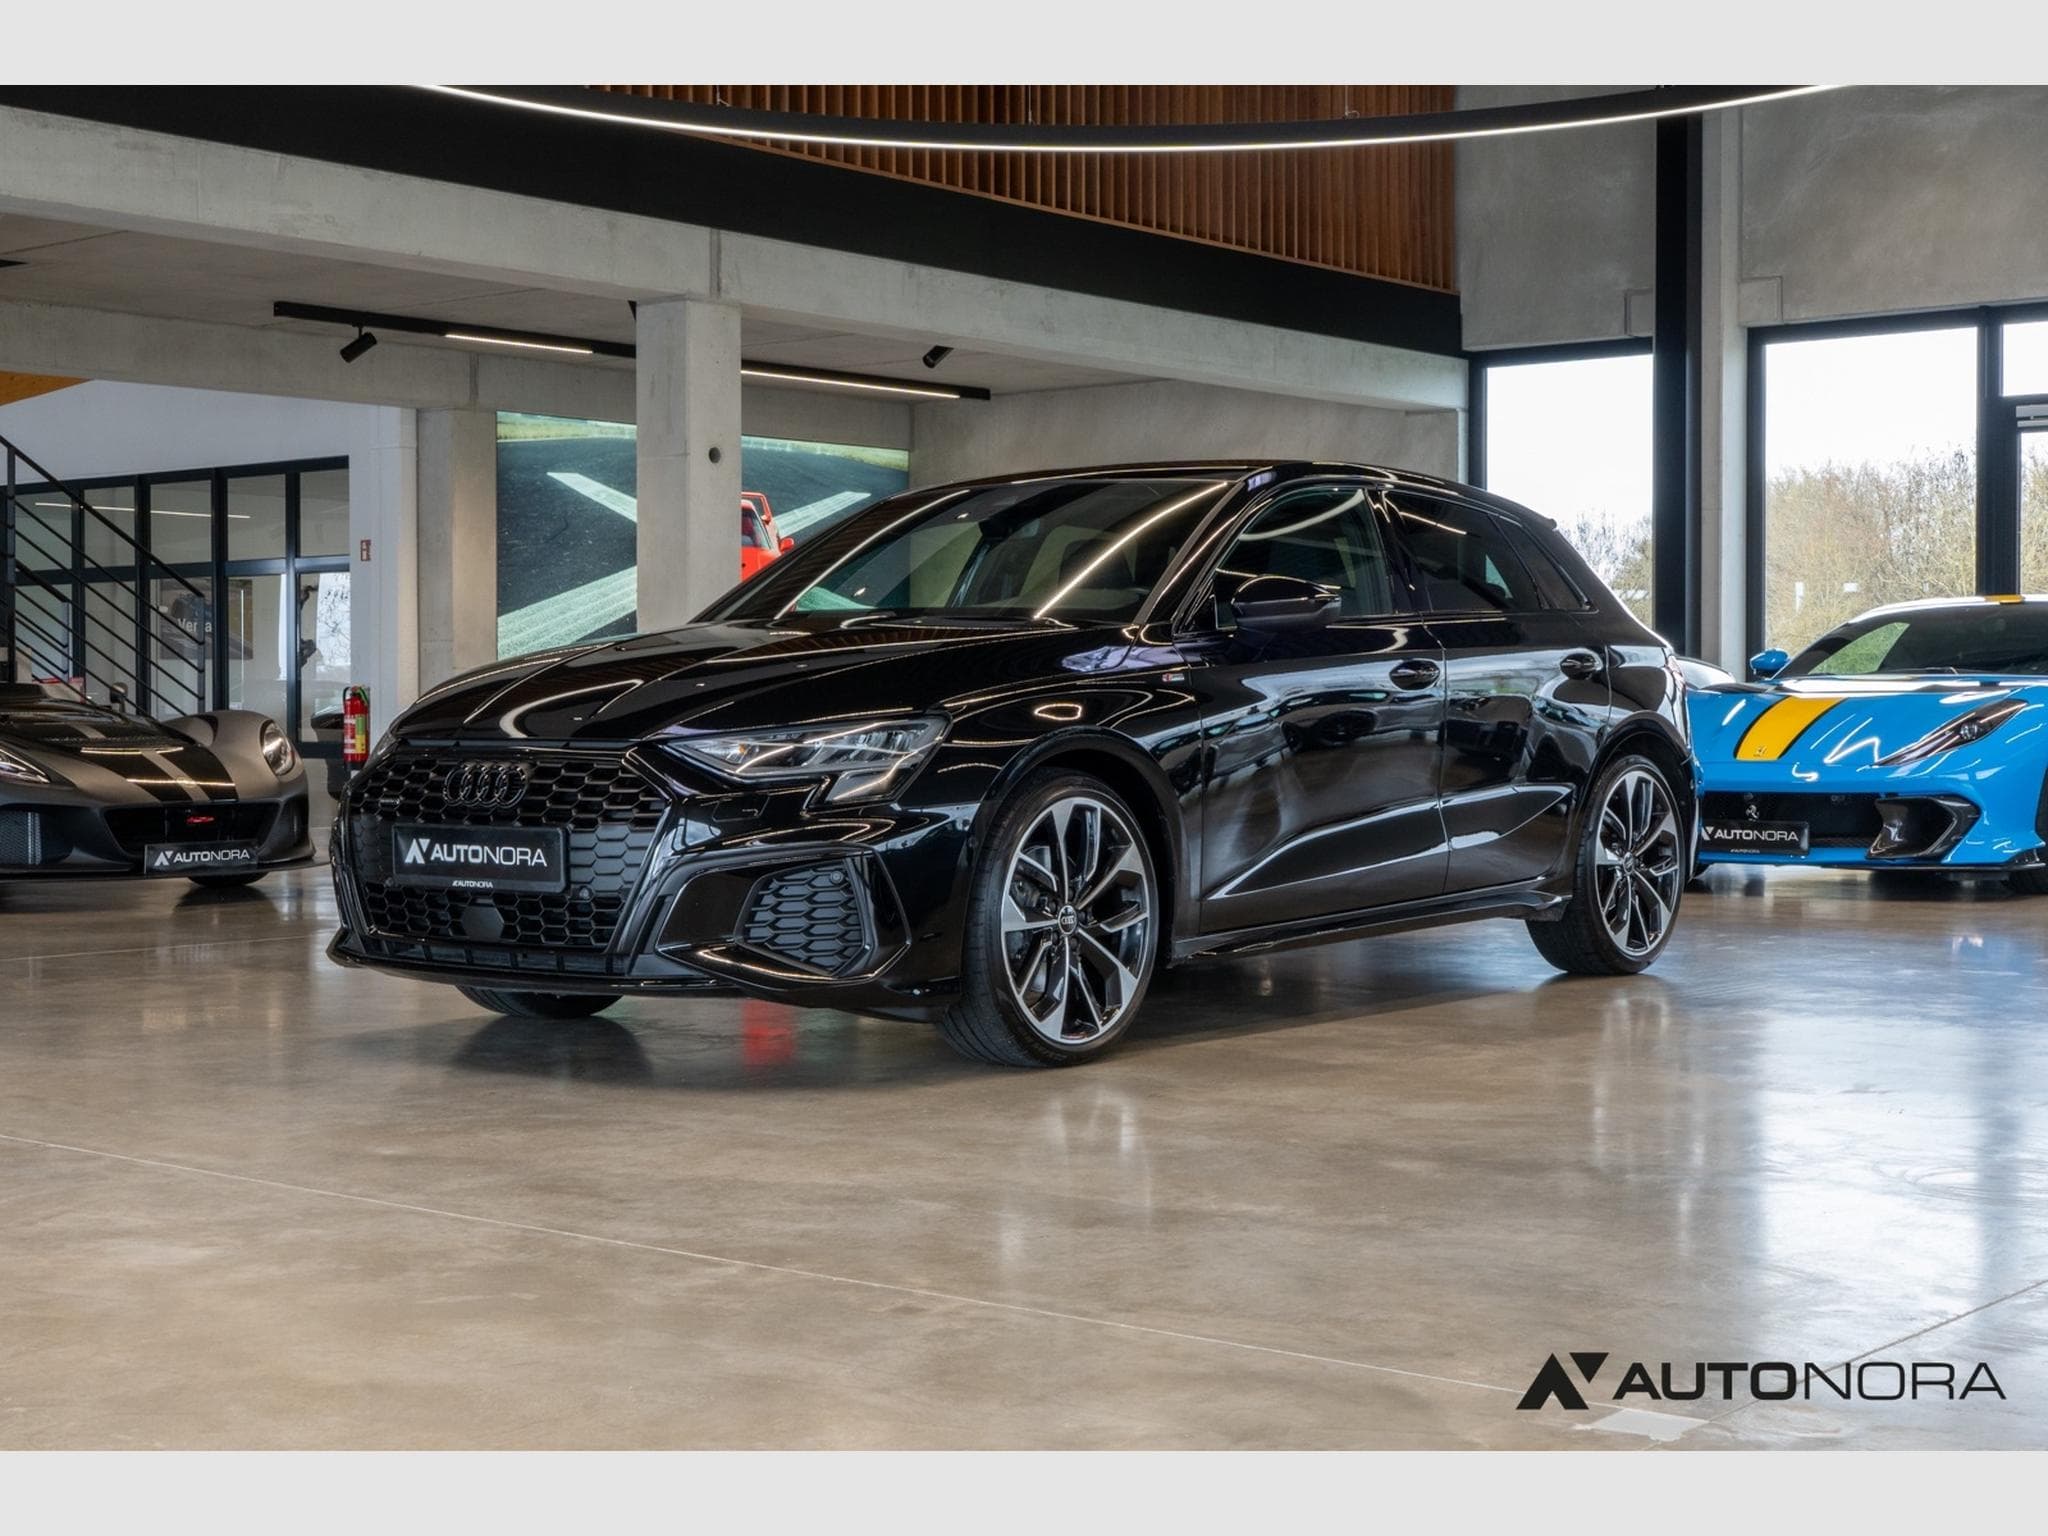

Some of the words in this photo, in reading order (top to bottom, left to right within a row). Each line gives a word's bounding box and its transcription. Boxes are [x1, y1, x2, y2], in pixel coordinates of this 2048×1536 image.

[177, 618, 212, 633] Vera
[1714, 828, 1799, 842] AUTONORA
[173, 849, 251, 864] AUTONORA
[430, 843, 548, 867] AUTONORA
